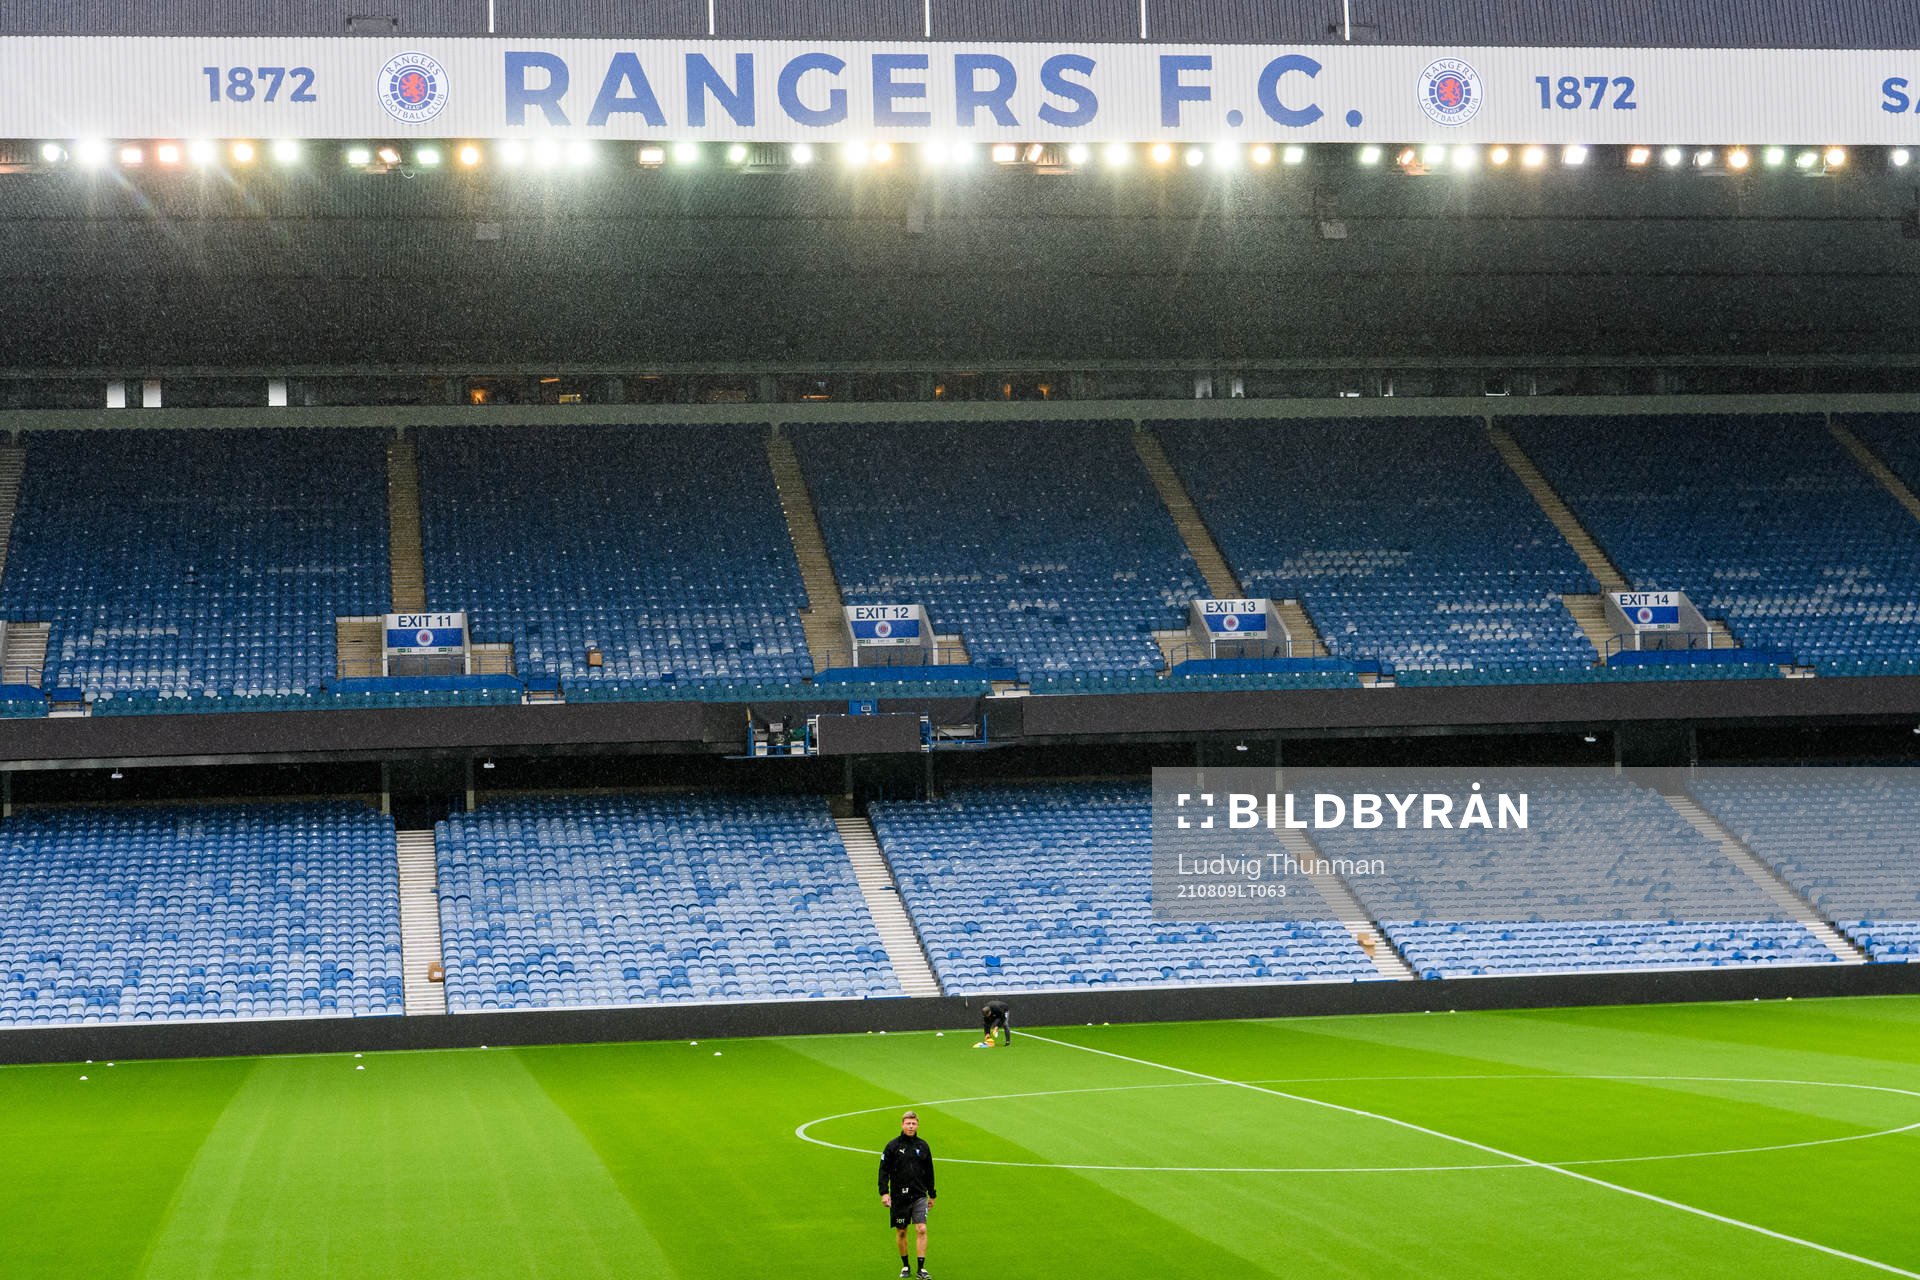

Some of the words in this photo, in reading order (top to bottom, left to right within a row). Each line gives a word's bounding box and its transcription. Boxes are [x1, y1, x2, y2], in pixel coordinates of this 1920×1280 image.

[385, 55, 440, 75] RANGERS
[1424, 61, 1475, 80] RANGERS
[203, 66, 317, 103] 1872
[505, 51, 1099, 127] RANGERS
[1159, 54, 1363, 128] F.C.
[1535, 76, 1637, 111] 1872
[1881, 77, 1920, 114] S
[383, 94, 427, 119] FOOTBALL
[1206, 601, 1236, 613] EXIT
[1241, 601, 1256, 613] 13
[1620, 594, 1650, 605] EXIT
[1654, 594, 1669, 605] 14
[398, 615, 432, 627] EXIT
[437, 615, 451, 627] 11
[856, 607, 888, 619] EXIT
[893, 606, 909, 619] 12
